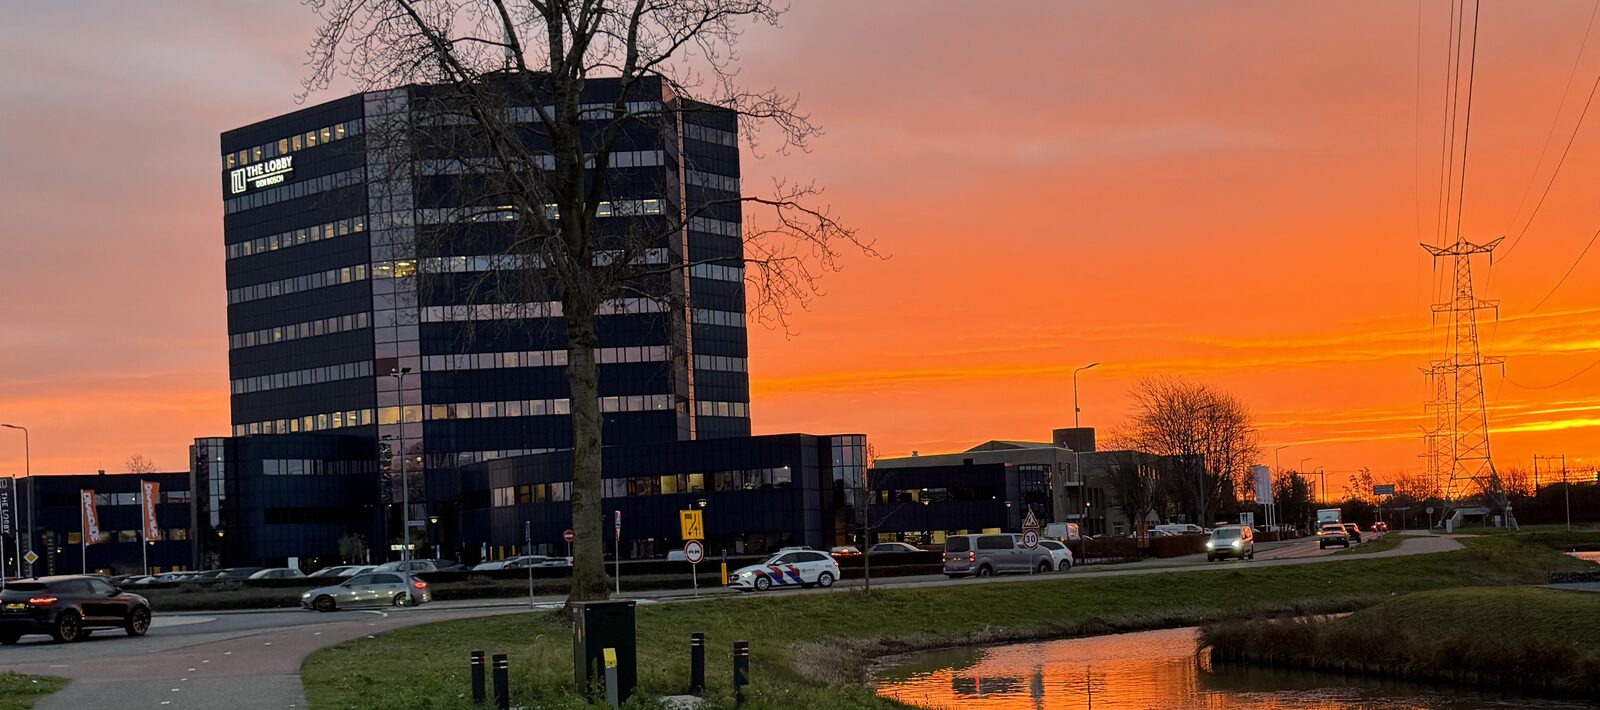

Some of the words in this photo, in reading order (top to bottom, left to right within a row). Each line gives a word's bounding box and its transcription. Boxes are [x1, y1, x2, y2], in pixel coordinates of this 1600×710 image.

[246, 163, 264, 177] THE
[264, 155, 293, 173] LOBBY
[1, 491, 9, 508] THE
[1026, 535, 1035, 543] 30
